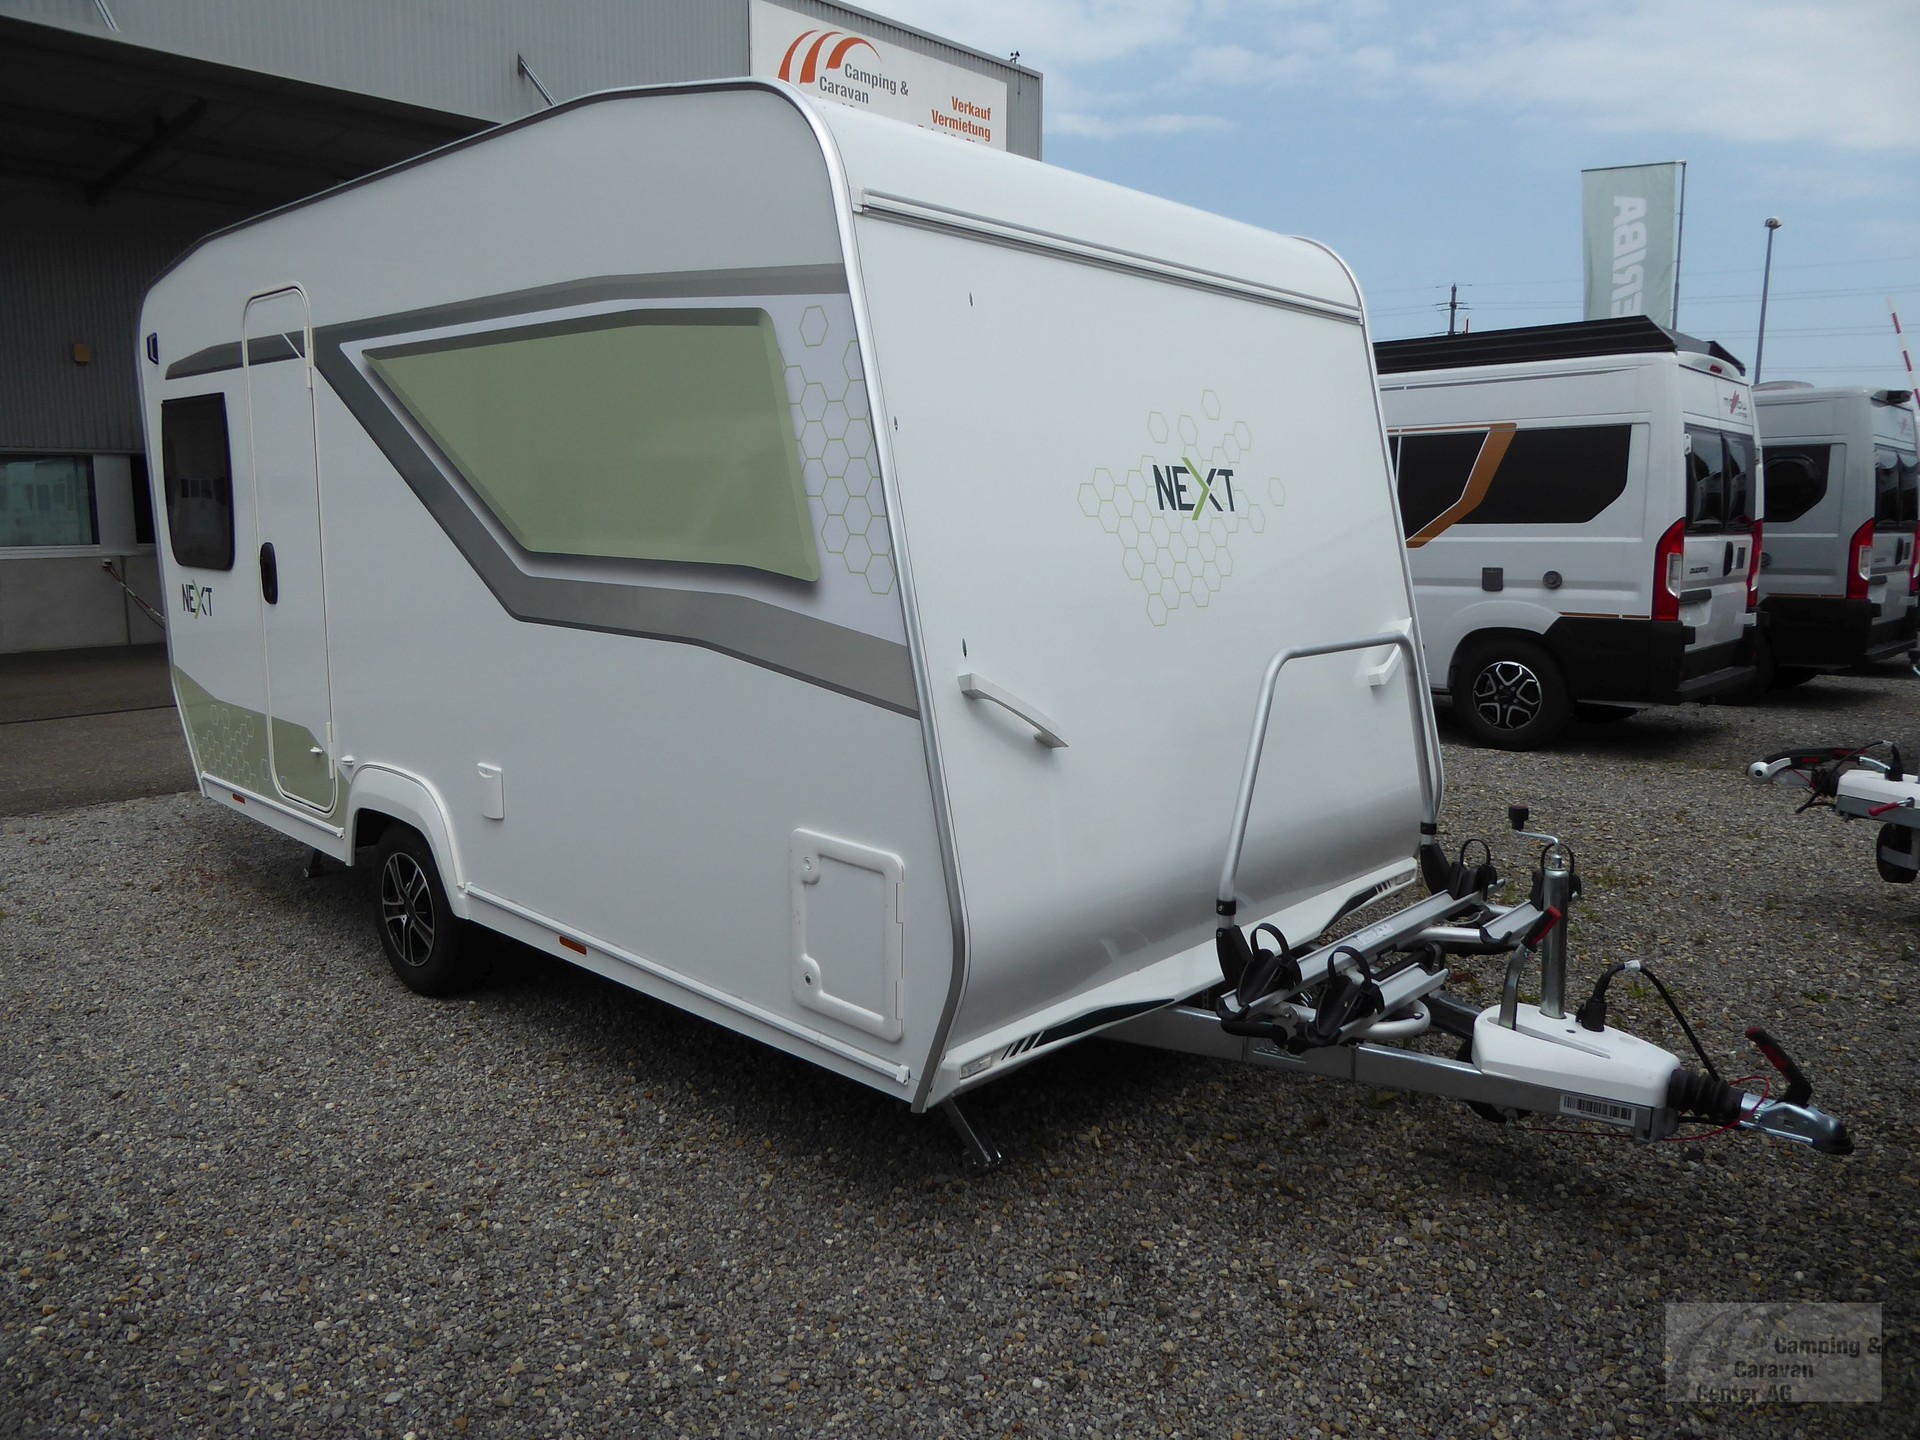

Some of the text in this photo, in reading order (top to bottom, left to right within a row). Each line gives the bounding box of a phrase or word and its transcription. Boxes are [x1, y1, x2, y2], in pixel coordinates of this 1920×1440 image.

[819, 76, 869, 104] Caravan
[844, 62, 909, 96] Camping &
[951, 96, 991, 121] Verkauf
[931, 109, 991, 142] Vermietung
[1152, 456, 1235, 521] NEXT
[181, 579, 213, 619] NEXT
